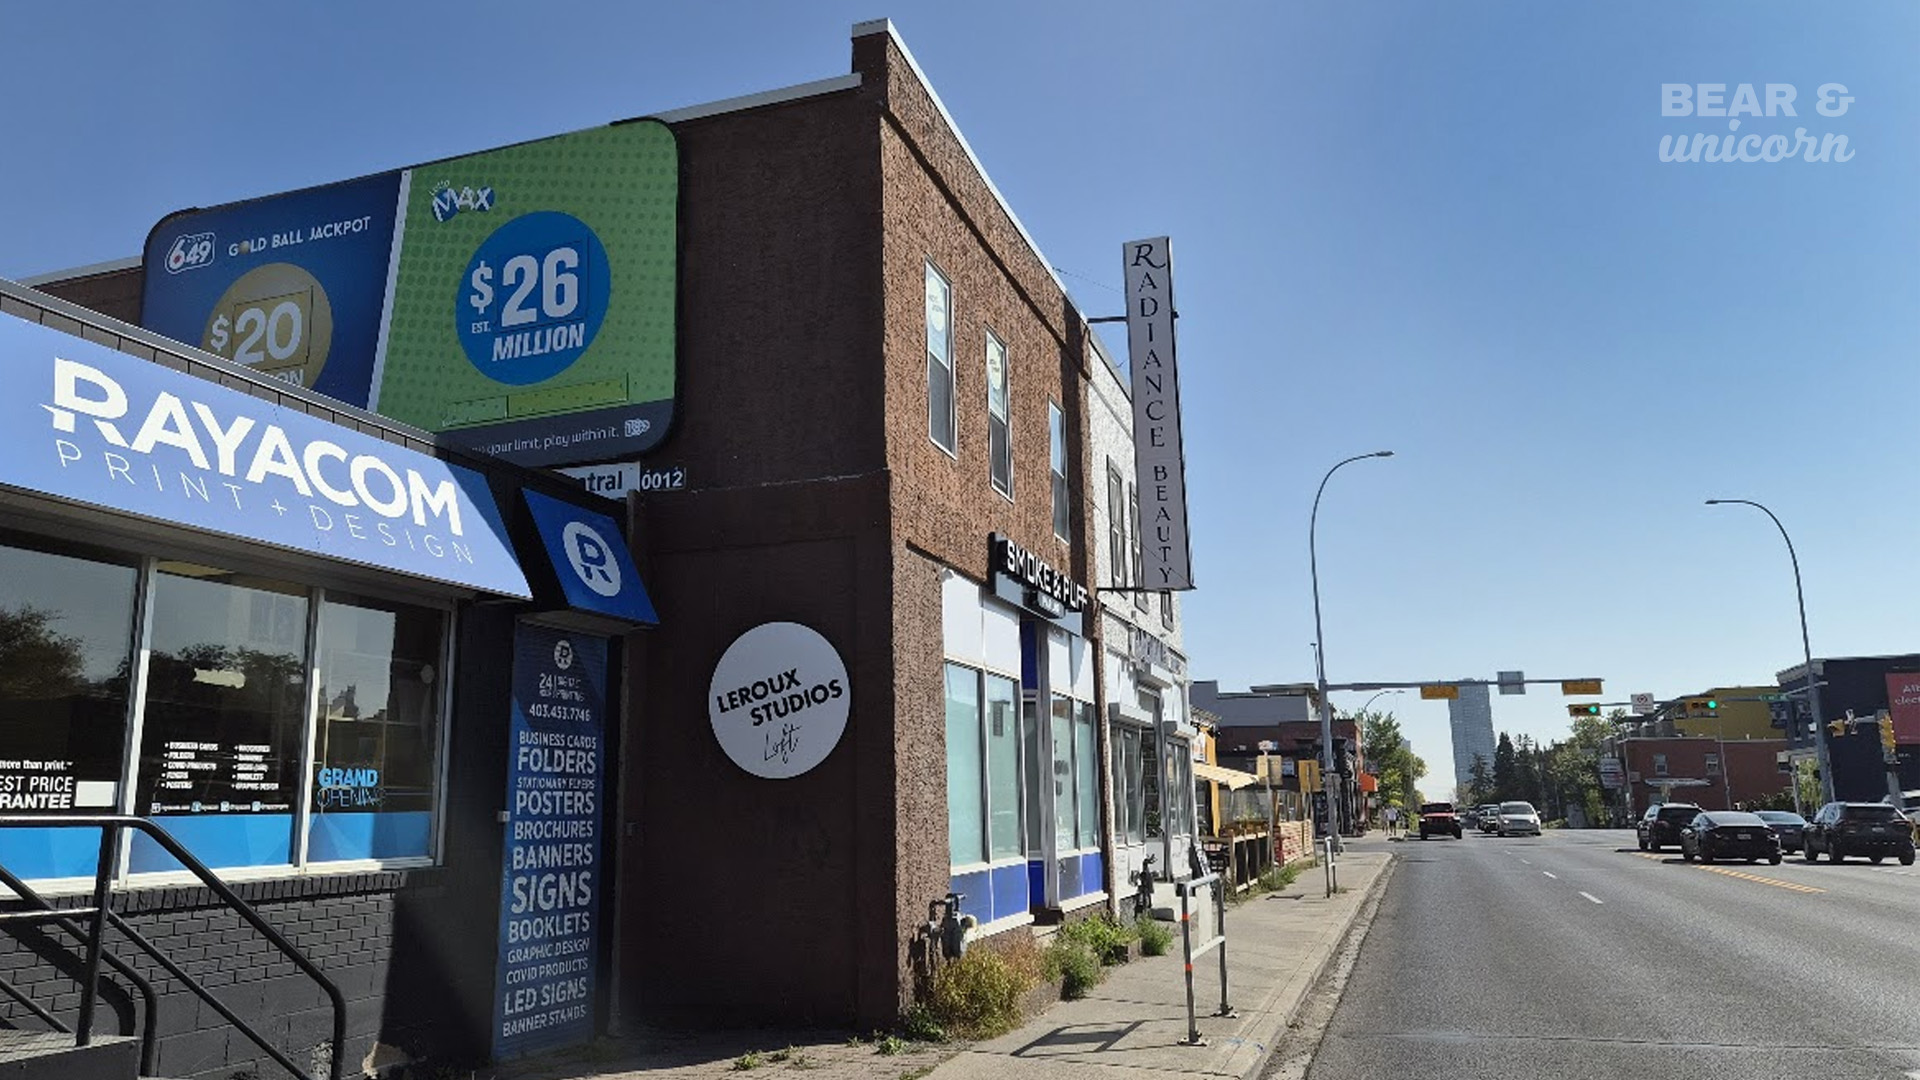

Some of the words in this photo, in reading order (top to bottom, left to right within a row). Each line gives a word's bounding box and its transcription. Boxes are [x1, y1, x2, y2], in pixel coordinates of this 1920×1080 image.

[432, 186, 492, 222] MAX
[272, 230, 304, 249] BALL
[309, 216, 371, 241] JACKPOT
[472, 321, 491, 334] EST.
[492, 323, 585, 361] MILLION
[1131, 243, 1166, 449] RADIANCE
[1153, 465, 1172, 584] BEAUTY
[40, 357, 463, 537] RAYACOM
[543, 434, 570, 450] play
[641, 470, 683, 490] 0012
[56, 439, 242, 511] PRINT
[309, 505, 474, 565] DESIGN
[1007, 539, 1052, 593] SMOKE
[1063, 574, 1088, 612] PUFF
[716, 668, 802, 714] LEROUX
[751, 679, 843, 726] STUDIOS
[519, 731, 565, 746] BUSINESS
[567, 735, 597, 749] CARDS
[23, 759, 42, 769] than
[517, 747, 597, 774] FOLDERS
[30, 776, 74, 792] PRICE
[318, 768, 378, 787] GRAND
[515, 790, 595, 815] POSTERS
[514, 820, 593, 840] BROCHURES
[512, 843, 593, 870] BANNERS
[511, 871, 592, 914] SIGNS
[508, 911, 590, 944] BOOKLETS
[507, 943, 553, 964] GRAPHIC
[555, 937, 590, 956] DESIGN
[506, 966, 537, 985] COVID
[539, 957, 588, 977] PRODUCTS
[504, 988, 537, 1016] LED
[540, 977, 587, 1007] SIGNS
[503, 1013, 547, 1037] BANNER
[549, 1004, 587, 1026] STANDS
